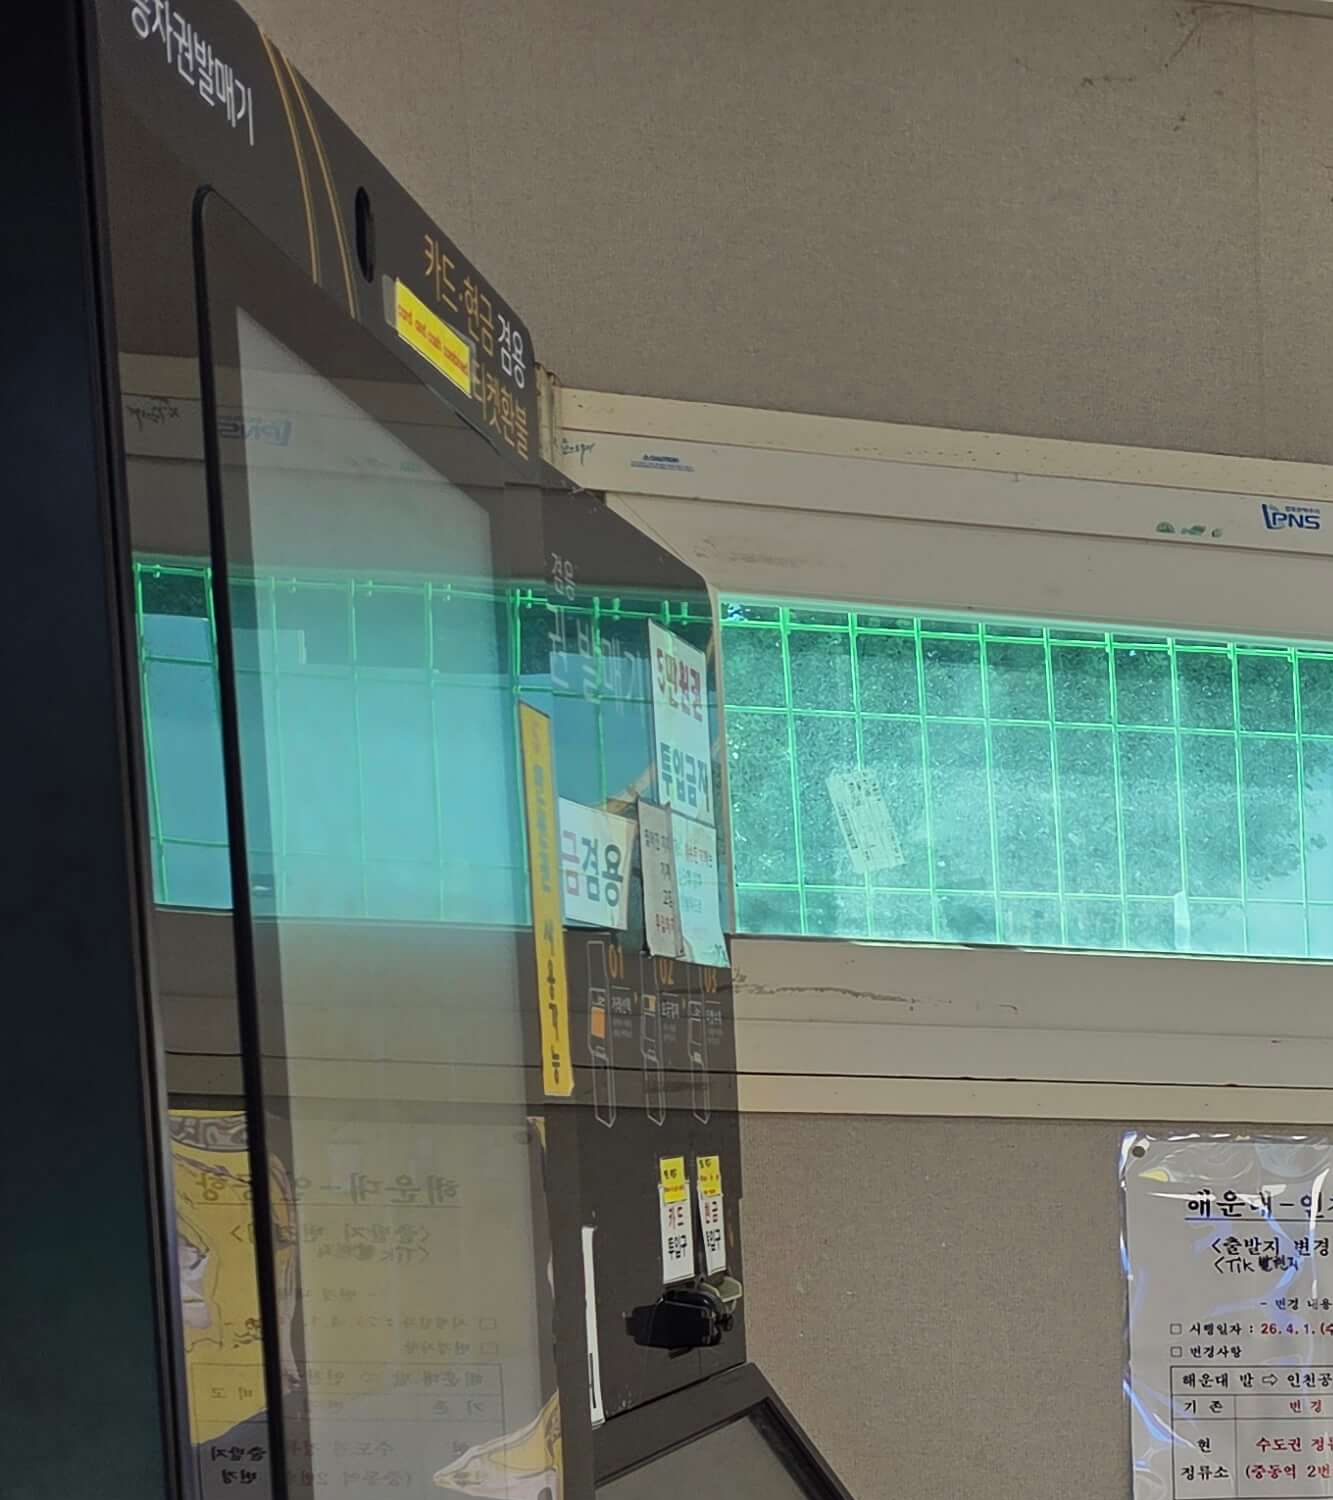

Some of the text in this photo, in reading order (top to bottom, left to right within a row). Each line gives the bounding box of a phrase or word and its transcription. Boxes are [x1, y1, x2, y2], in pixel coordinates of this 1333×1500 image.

[1268, 508, 1320, 531] PNS
[608, 944, 624, 979] 01
[1294, 1237, 1329, 1257] 변경
[1189, 1323, 1242, 1336] 시행일자
[1189, 1346, 1242, 1359] 변경사항
[1182, 1373, 1229, 1388] 해운대
[1256, 1437, 1302, 1452] 수도권
[1180, 1465, 1229, 1481] 정류소
